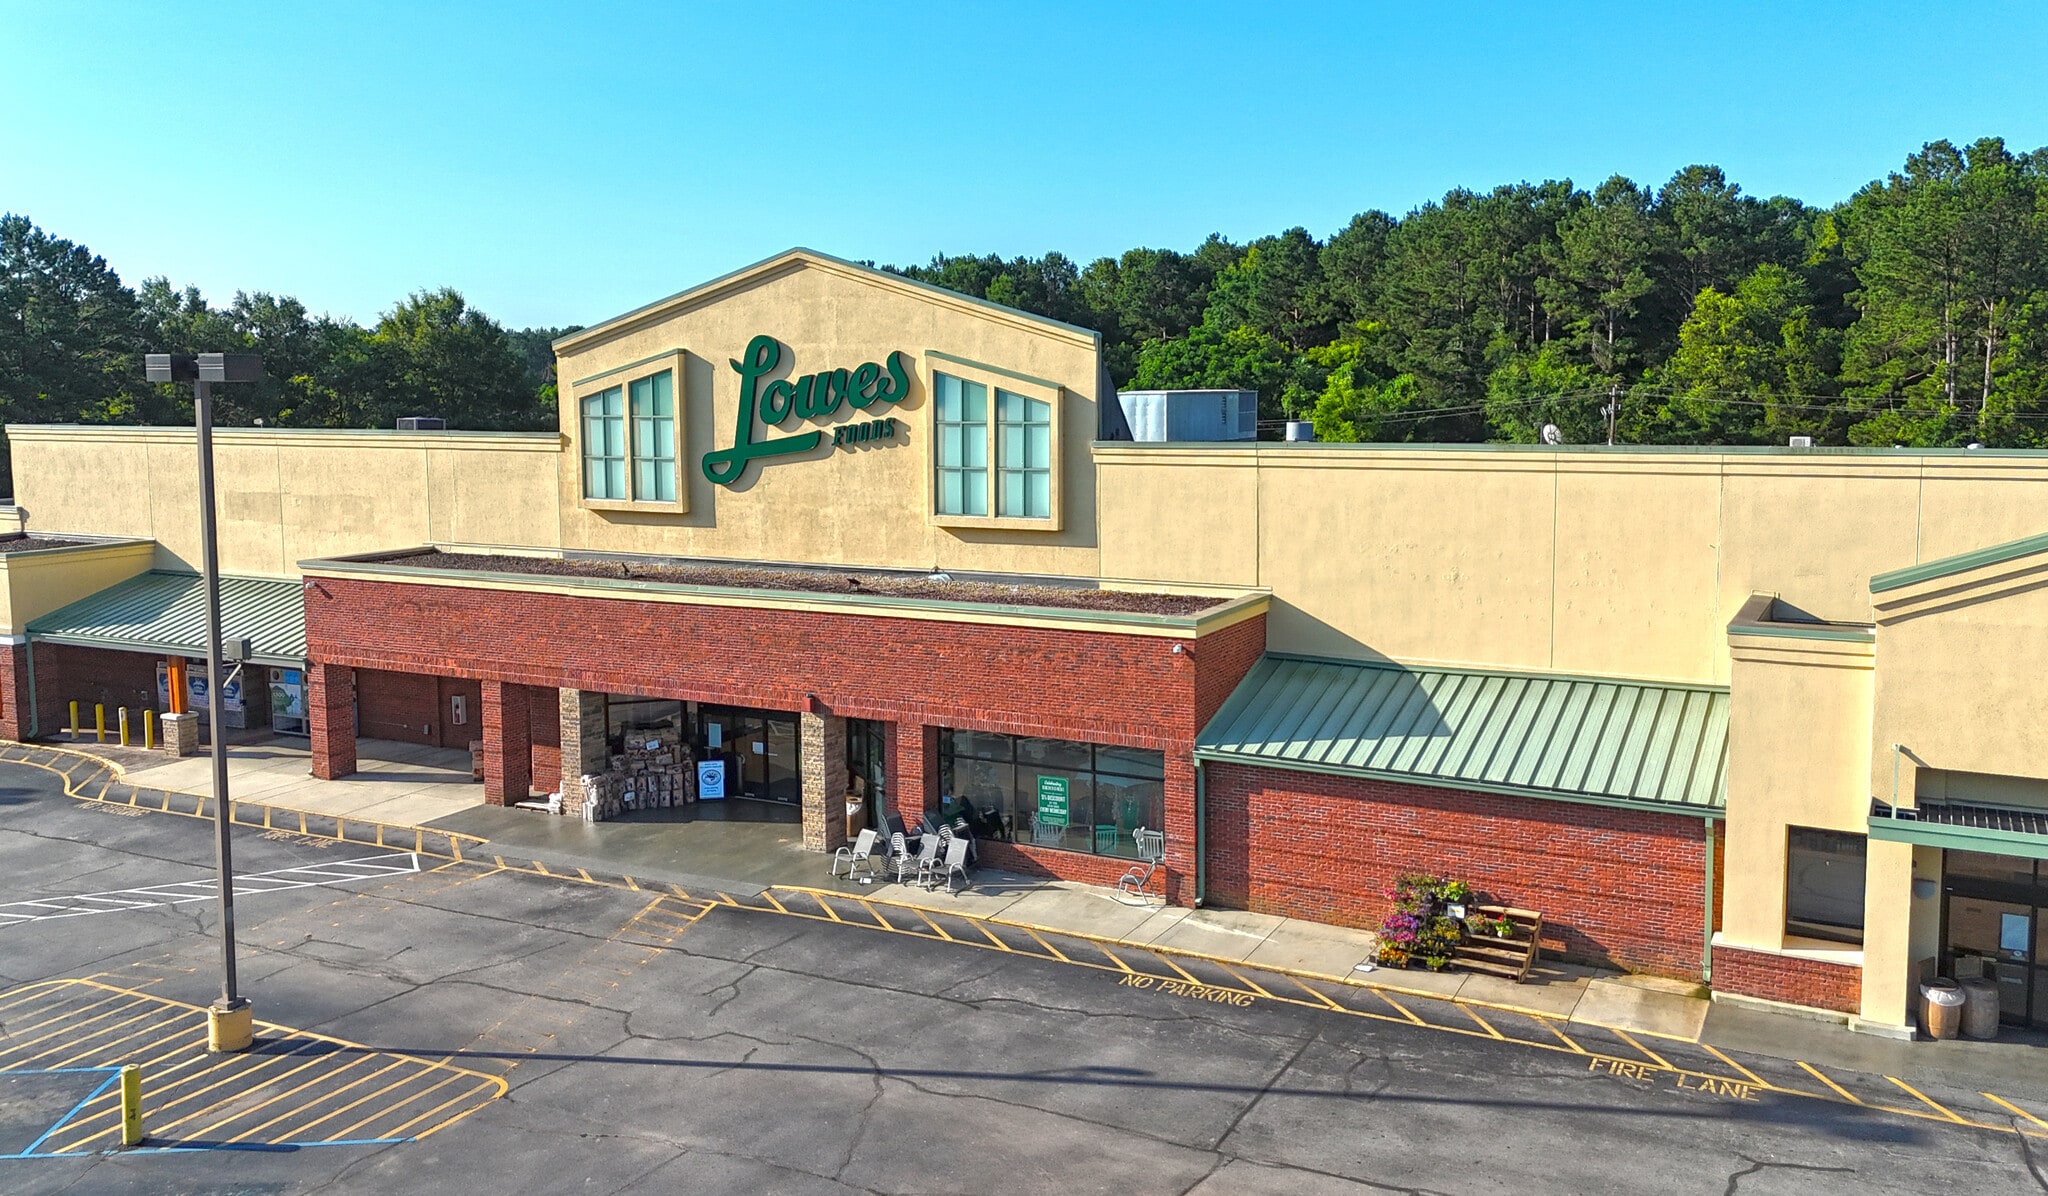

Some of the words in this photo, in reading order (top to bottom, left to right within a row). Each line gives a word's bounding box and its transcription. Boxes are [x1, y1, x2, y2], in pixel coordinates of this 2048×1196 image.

[702, 335, 910, 484] Lowes
[832, 417, 896, 446] FOODS
[1119, 974, 1153, 989] NO
[1156, 980, 1255, 1007] PARKING
[1588, 1057, 1658, 1083] FIRE
[1676, 1073, 1762, 1102] LANE
